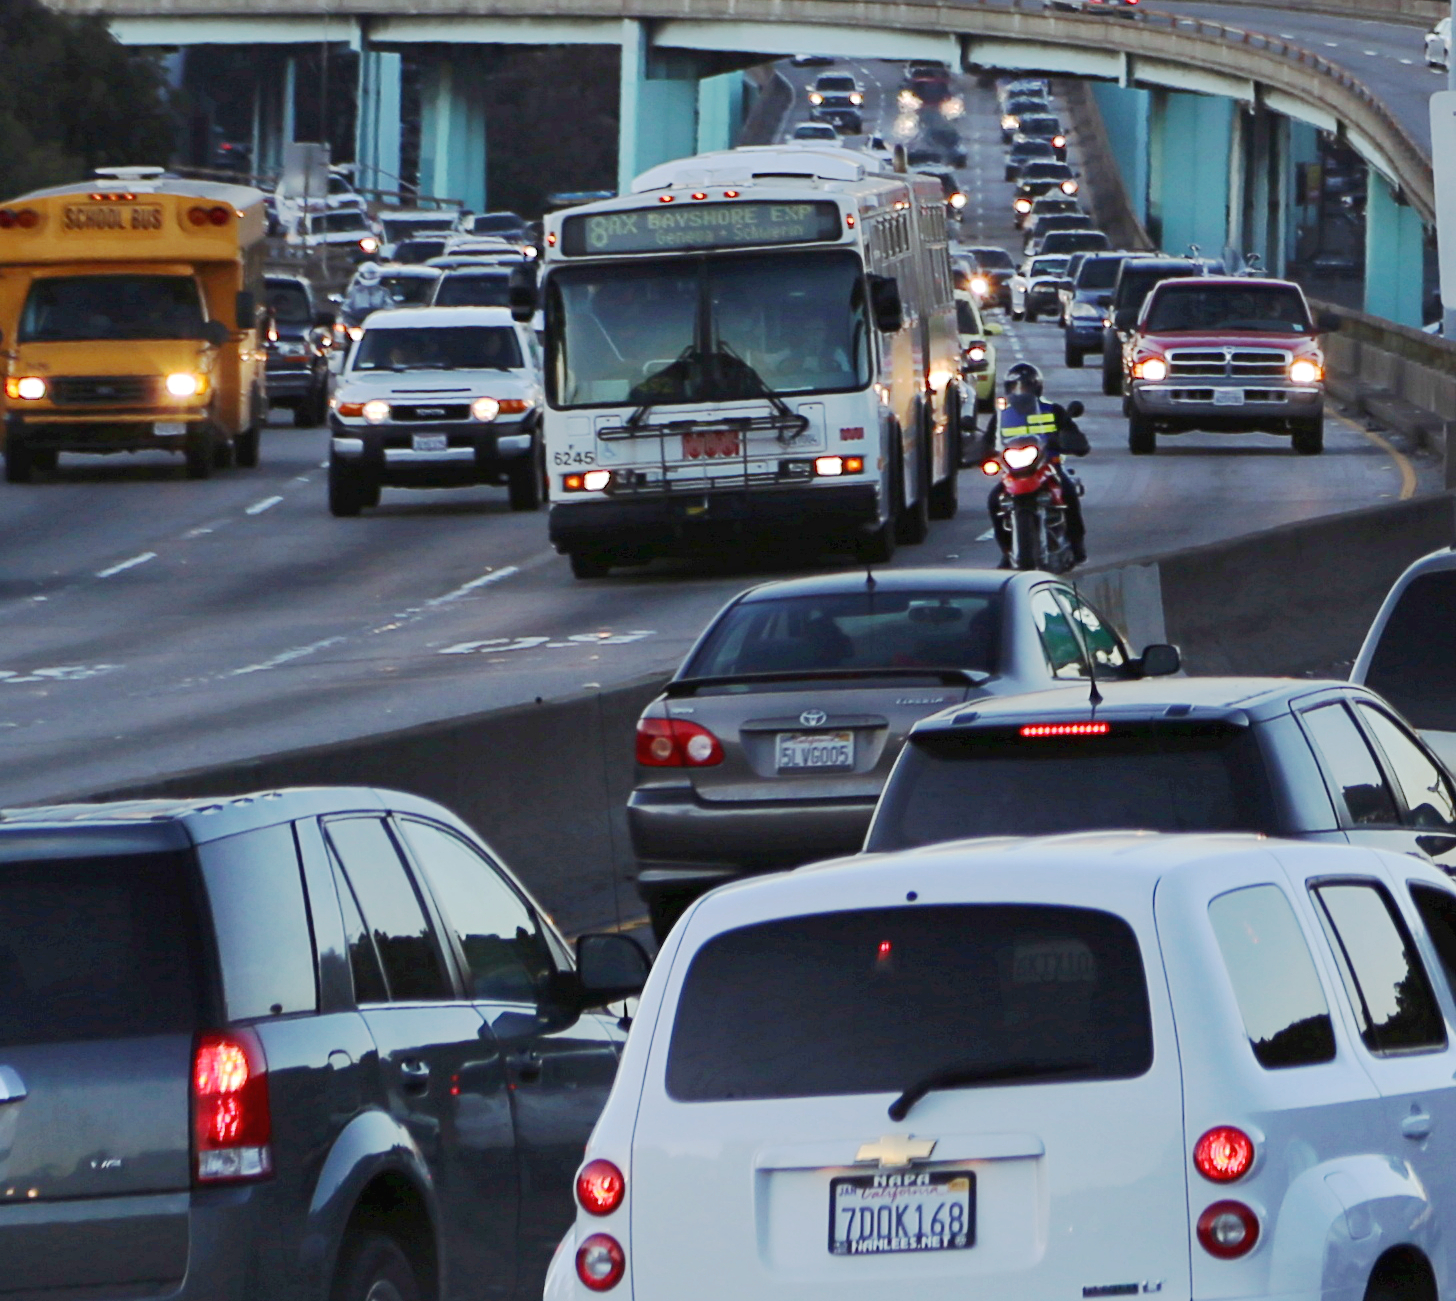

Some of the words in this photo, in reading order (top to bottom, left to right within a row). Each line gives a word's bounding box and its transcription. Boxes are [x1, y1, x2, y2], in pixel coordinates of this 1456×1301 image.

[64, 207, 126, 231] SCHOOL
[132, 206, 163, 230] BUS
[649, 206, 758, 230] BAYSHORE
[769, 202, 815, 223] EXP
[553, 451, 597, 466] 6245
[779, 745, 849, 766] 5LVG005
[873, 1173, 931, 1188] NAPA
[838, 1186, 857, 1197] JAN
[861, 1185, 941, 1203] California
[851, 1234, 951, 1254] HANLEES.NET
